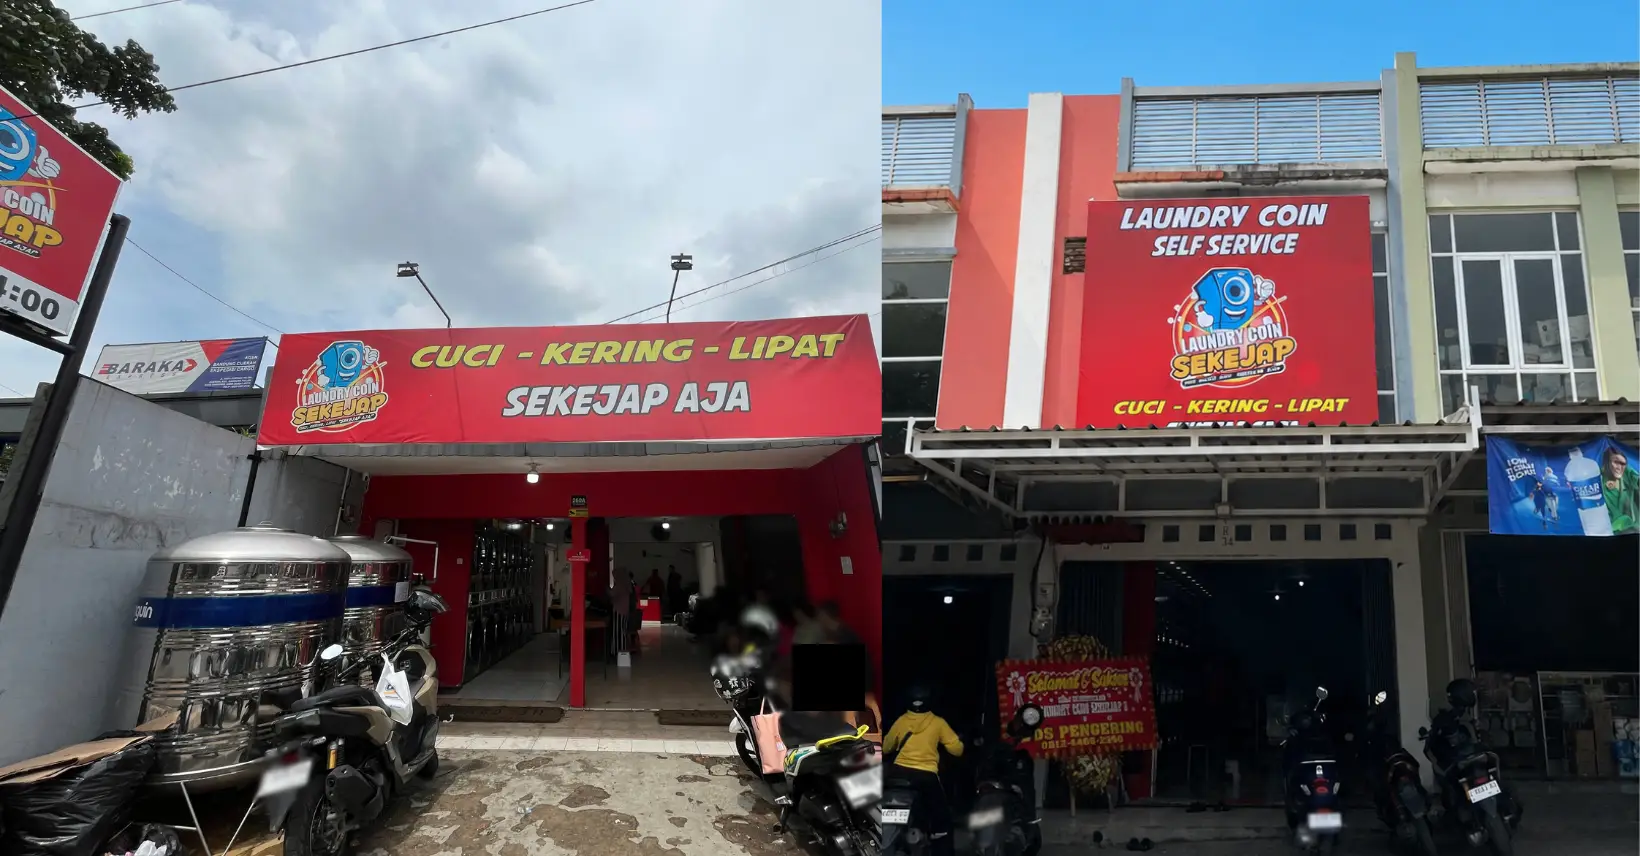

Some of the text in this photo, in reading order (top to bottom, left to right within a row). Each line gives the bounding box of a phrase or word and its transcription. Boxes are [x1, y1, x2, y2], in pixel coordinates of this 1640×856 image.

[4, 188, 55, 226] COIN
[1119, 203, 1329, 230] LAUNDRY COIN
[1150, 232, 1299, 257] SELF SERVICE
[410, 344, 504, 369] CUCI
[540, 338, 695, 367] KERING
[728, 333, 846, 361] LIPAT
[1181, 322, 1283, 355] LAUNDRY COIN
[107, 359, 184, 375] BARAKA
[1171, 337, 1295, 379] SEKEJAP
[292, 393, 387, 425] SEKEJAP
[303, 382, 379, 406] LAUNDRY COIN
[502, 381, 751, 418] SEKEJAP AJA
[1113, 400, 1167, 415] CUCI
[1186, 399, 1270, 414] KERING
[1288, 398, 1350, 412] LIPAT
